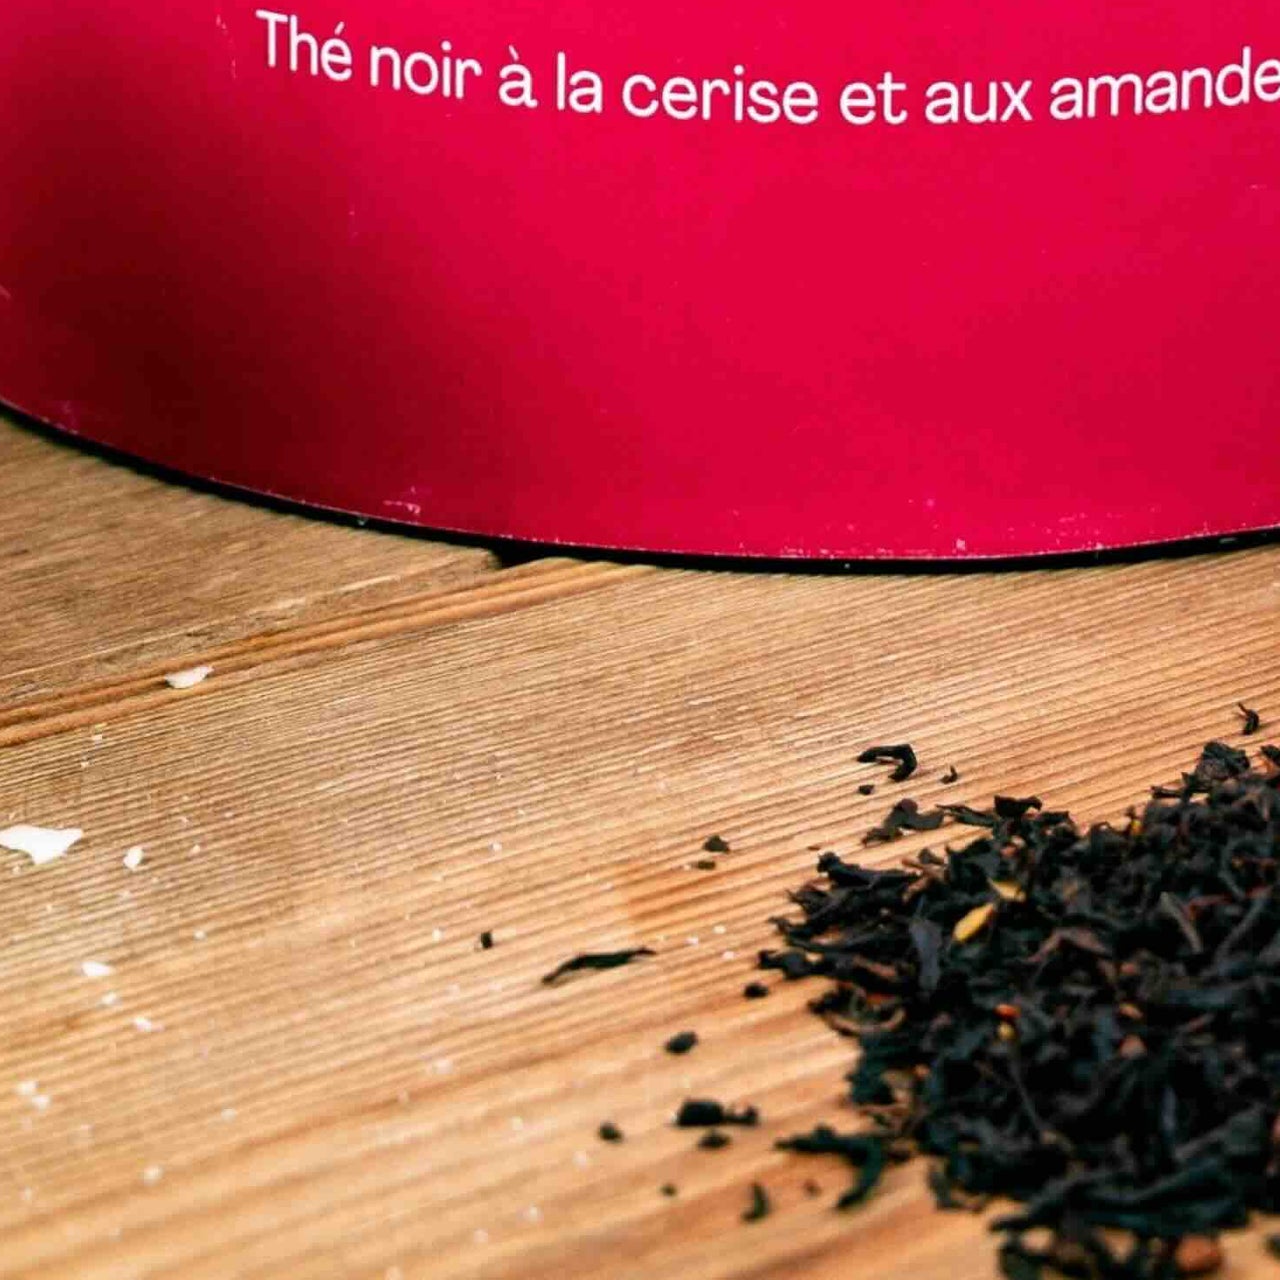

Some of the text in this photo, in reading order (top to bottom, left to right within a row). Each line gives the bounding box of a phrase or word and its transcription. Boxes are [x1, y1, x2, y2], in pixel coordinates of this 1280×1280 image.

[256, 10, 352, 81] Thé
[370, 41, 482, 98] noir
[499, 46, 538, 108] à
[557, 52, 603, 113] la
[622, 65, 818, 124] cerise
[839, 71, 907, 125] et
[925, 80, 1032, 124] aux
